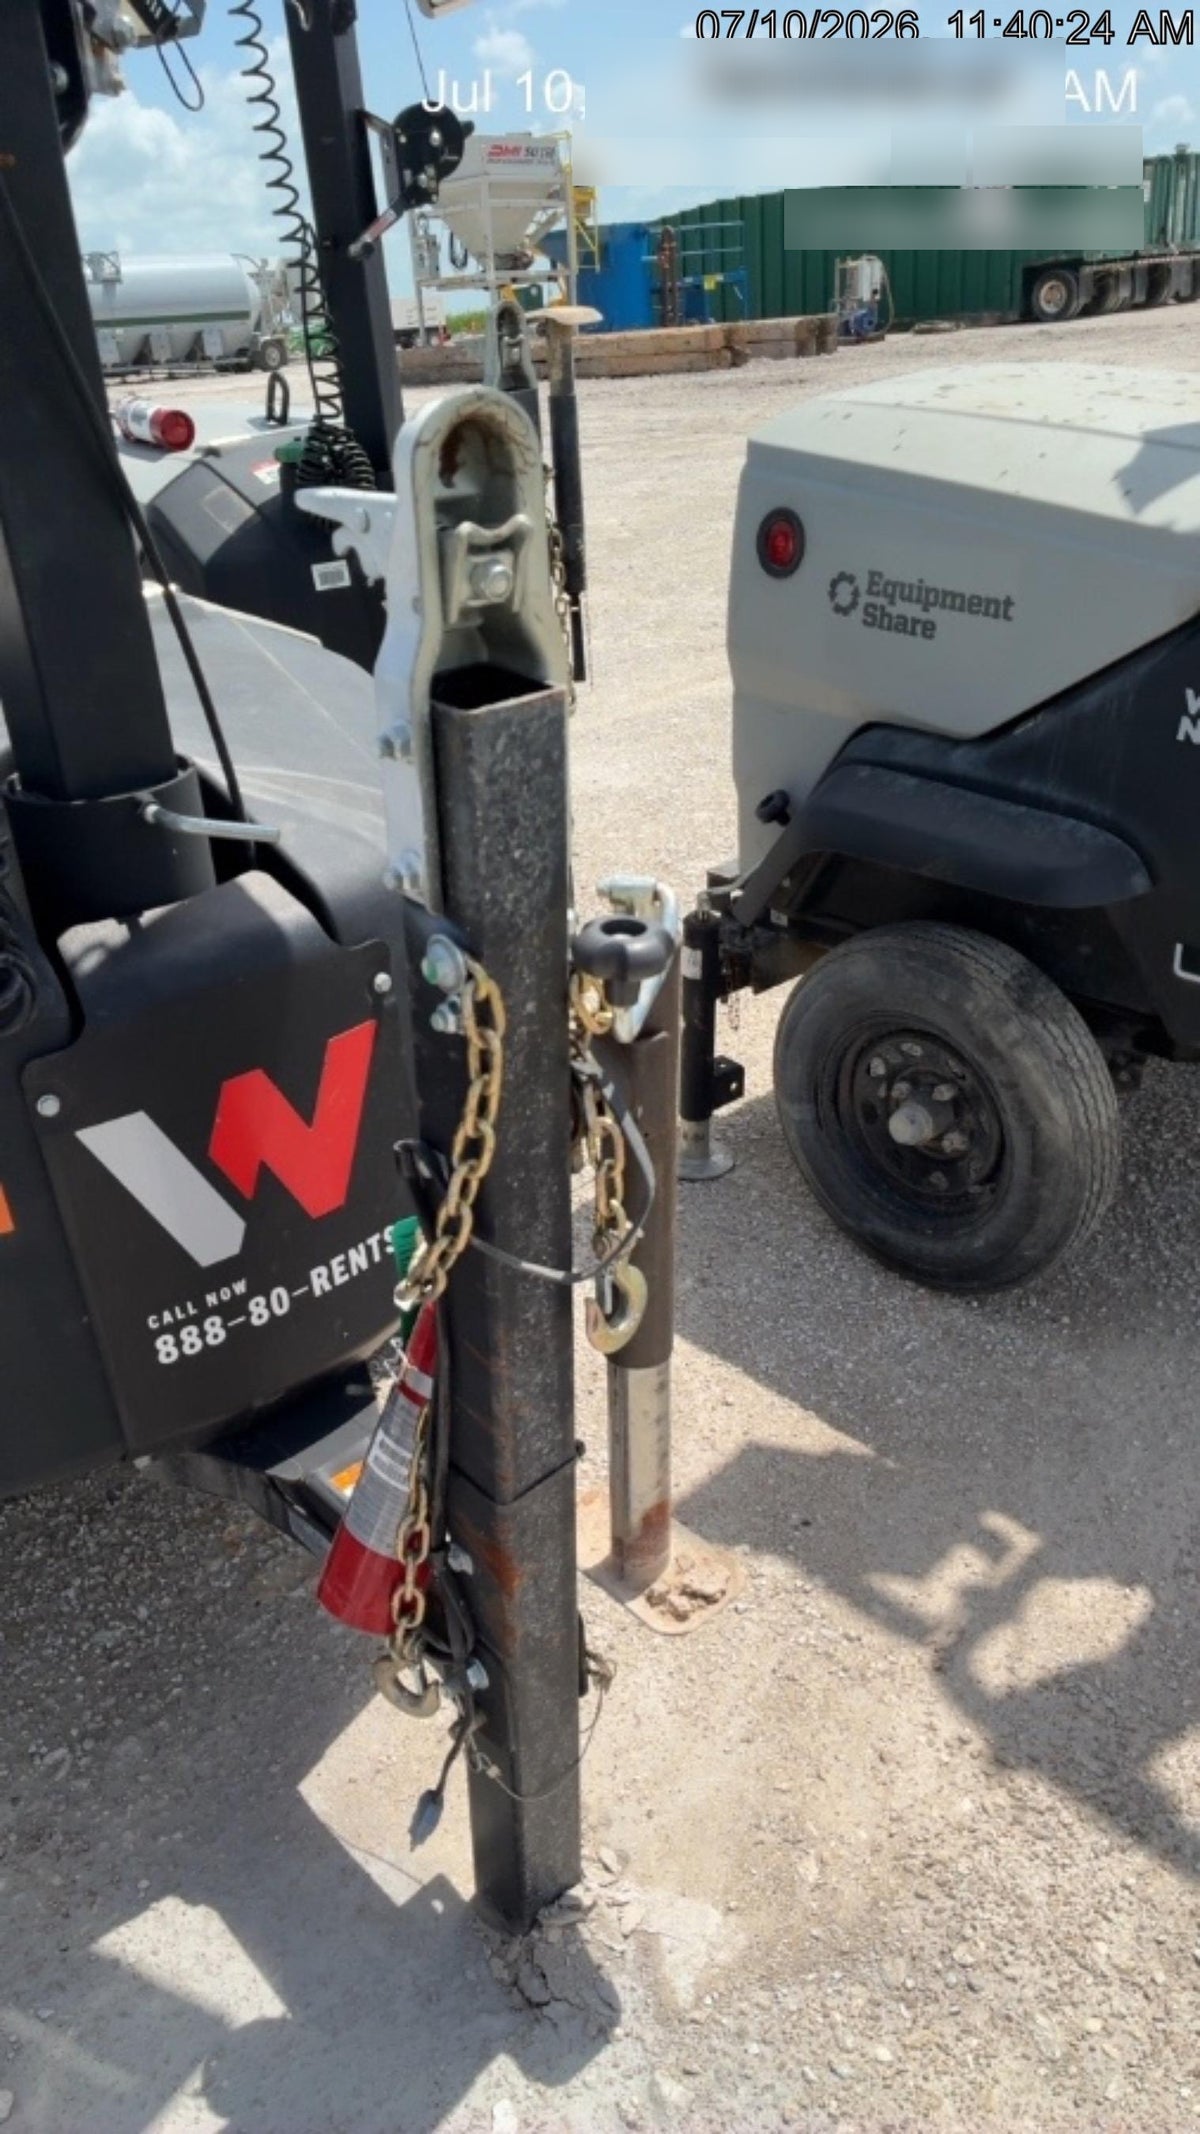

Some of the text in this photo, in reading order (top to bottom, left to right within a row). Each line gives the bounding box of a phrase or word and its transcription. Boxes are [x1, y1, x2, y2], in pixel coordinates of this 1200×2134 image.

[862, 602, 937, 640] Share
[866, 569, 1016, 622] Equipment
[147, 1278, 247, 1330] CALL NOW
